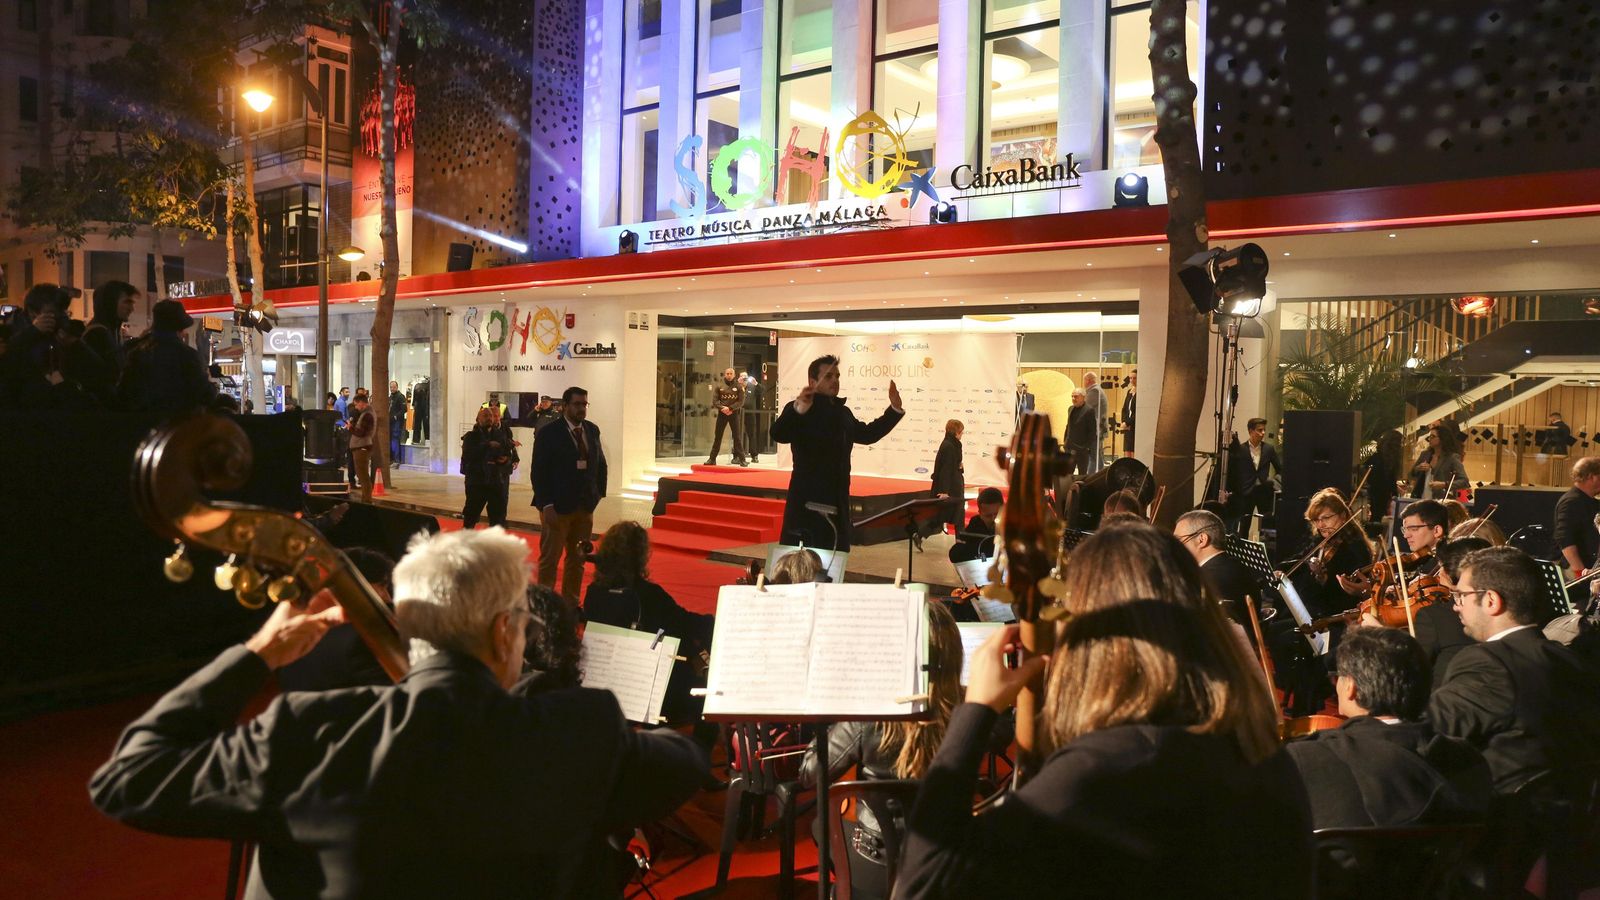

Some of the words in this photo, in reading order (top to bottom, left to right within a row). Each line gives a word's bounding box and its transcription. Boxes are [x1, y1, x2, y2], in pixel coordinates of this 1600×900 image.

[670, 105, 919, 219] SOHO
[950, 152, 1081, 191] CaixaBank
[648, 225, 695, 241] TEATRO
[700, 218, 752, 236] MÚSICA
[763, 213, 814, 229] DANZA
[819, 204, 888, 223] MÁLAGA
[169, 281, 196, 299] HOTEL
[463, 304, 566, 356] SOHO
[573, 342, 617, 355] CaixaBank
[850, 342, 877, 353] SOHO
[487, 363, 509, 372] MÚSICA
[513, 364, 534, 372] DANZA
[540, 364, 566, 372] MÁLAGA
[847, 364, 855, 378] A
[859, 364, 903, 378] CHORUS
